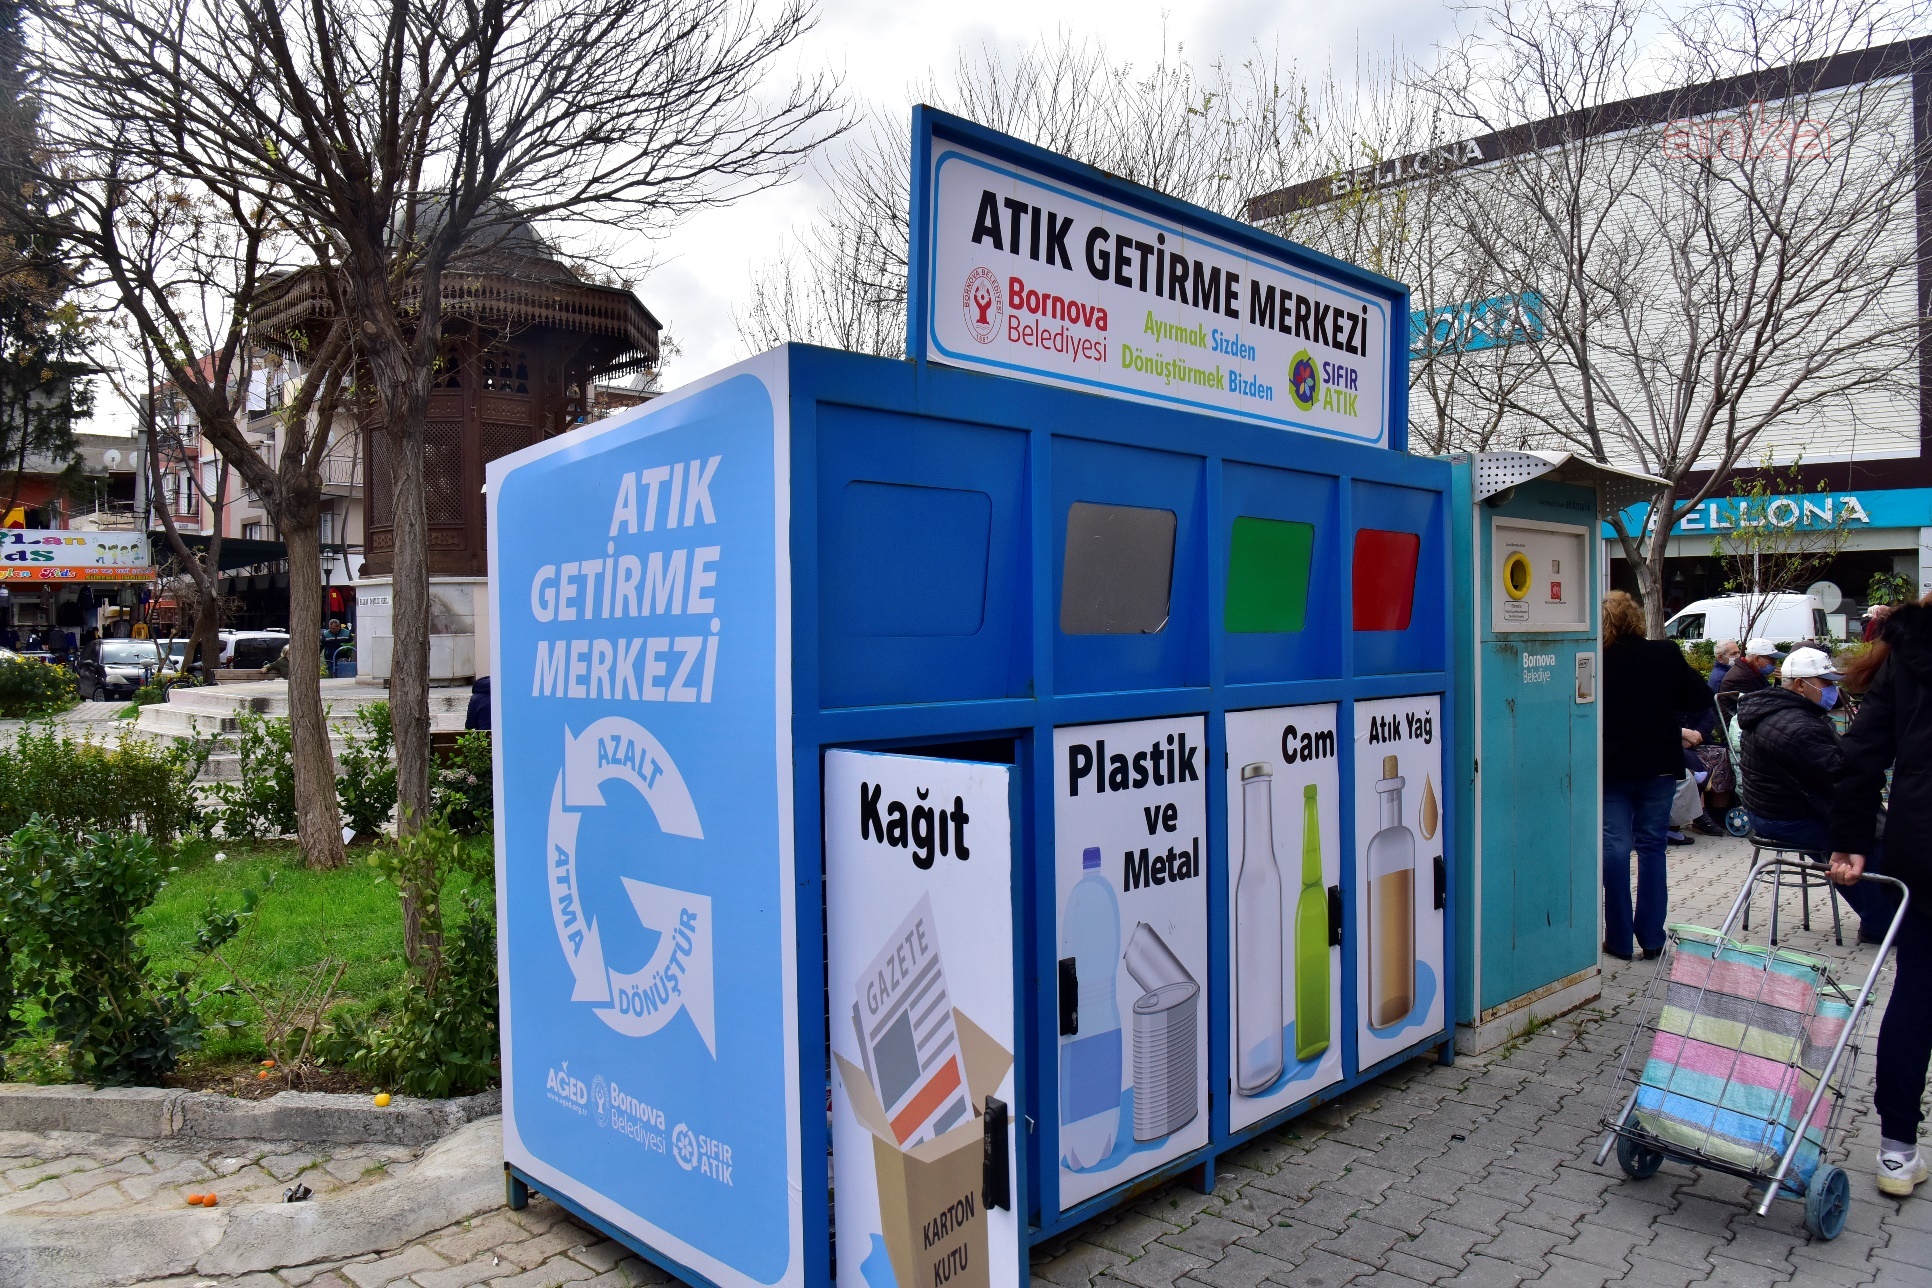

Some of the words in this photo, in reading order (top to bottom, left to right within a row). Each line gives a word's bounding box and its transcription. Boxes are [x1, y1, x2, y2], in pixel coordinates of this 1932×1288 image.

[971, 190, 1074, 271] ATIK
[1085, 226, 1240, 319] GETİRME
[1249, 279, 1368, 358] MERKEZİ
[1008, 276, 1108, 332] Bornova
[1008, 314, 1107, 363] Belediyesi
[1143, 310, 1207, 349] Ayırmak
[1211, 328, 1256, 362] Sizden
[1121, 343, 1225, 391] Dönüştürmek
[1228, 369, 1273, 402] Bizden
[1322, 361, 1359, 392] SIFIR
[1322, 386, 1359, 418] ATIK
[608, 454, 723, 537] ATIK
[0, 549, 55, 562] ds
[39, 567, 76, 579] Kids
[530, 540, 721, 623] GETİRME
[531, 617, 721, 704] MERKEZİ
[1523, 652, 1556, 668] Bornova
[1281, 724, 1335, 765] Cam
[1369, 714, 1402, 745] Atık
[1405, 710, 1433, 745] Yağ
[597, 734, 664, 791] AZALT
[1068, 732, 1200, 797] Plastik
[860, 781, 970, 870] Kağıt
[1143, 802, 1178, 836] ve
[1123, 836, 1200, 893] Metal
[554, 842, 585, 959] ATMA
[618, 906, 698, 1018] DÖNÜŞTÜR
[866, 917, 929, 1016] GAZETE
[546, 1091, 588, 1116] www.aged.org.tr
[610, 1081, 666, 1131] Bornova
[611, 1108, 666, 1155] Belediyesi
[698, 1134, 733, 1165] SIFIR
[700, 1154, 734, 1187] ATIK
[923, 1190, 975, 1251] KARTON
[933, 1242, 968, 1288] KUTU
